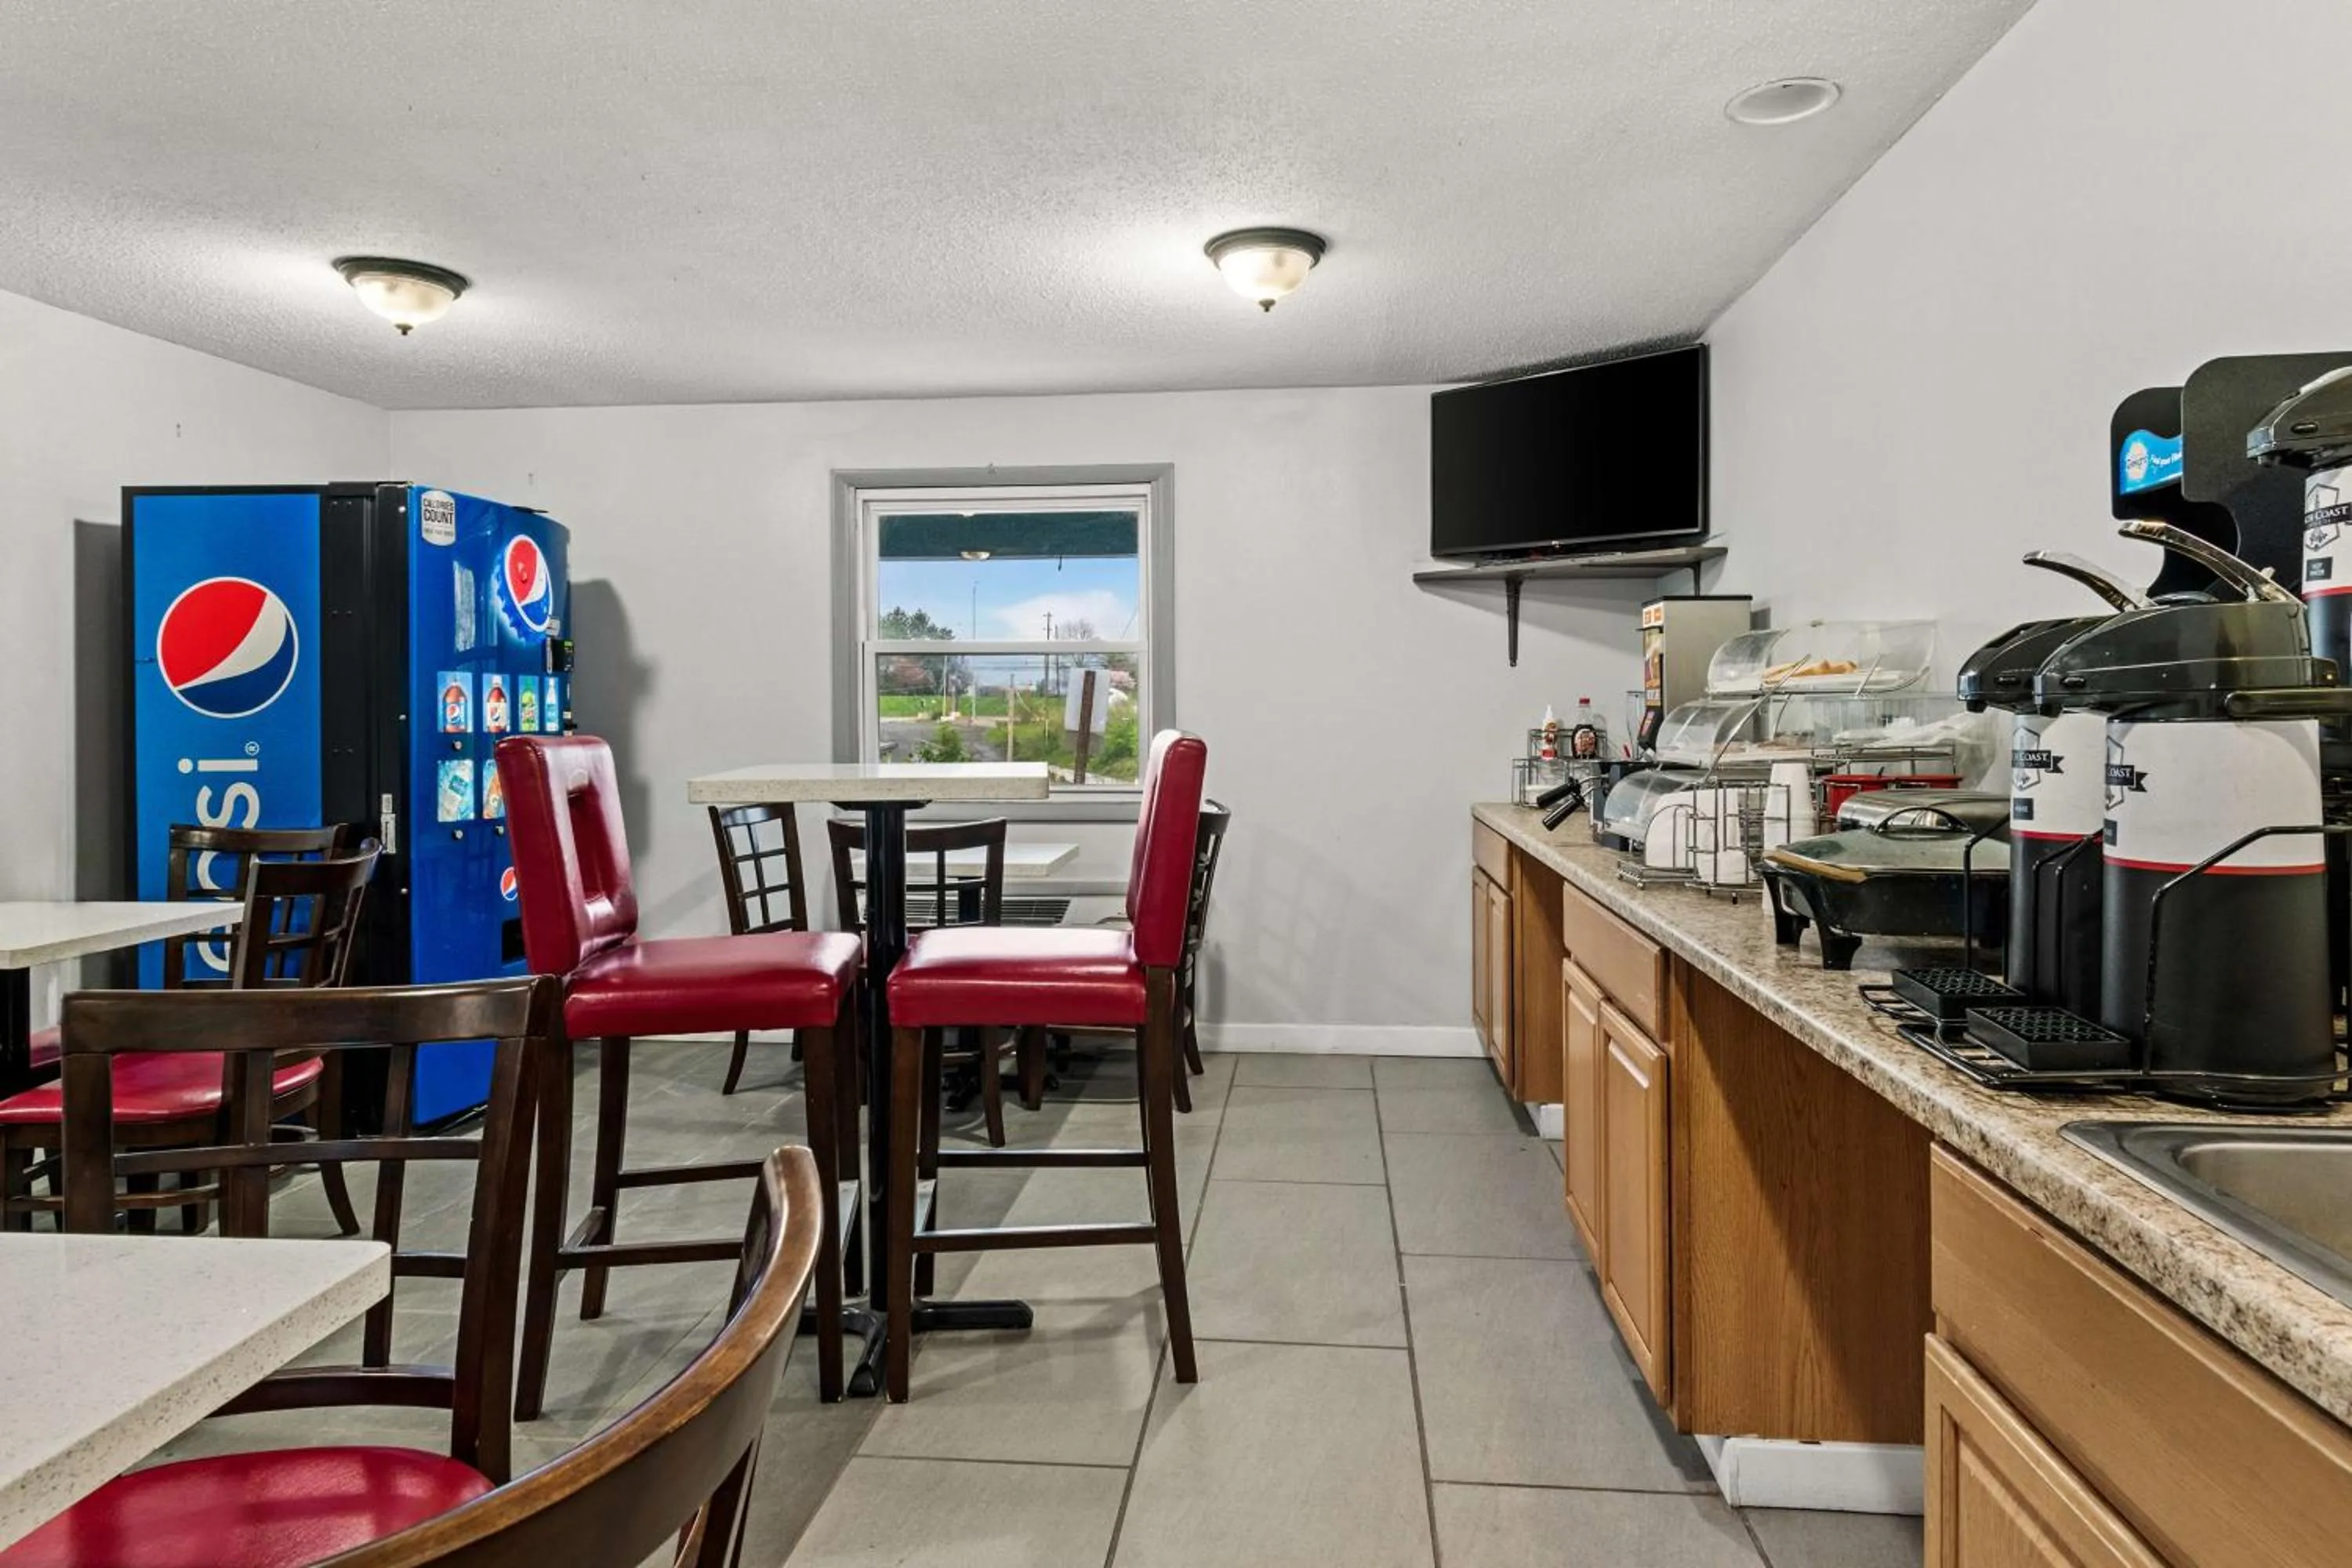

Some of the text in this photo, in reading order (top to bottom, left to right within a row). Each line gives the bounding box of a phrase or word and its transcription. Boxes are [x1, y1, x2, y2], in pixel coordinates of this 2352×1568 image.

[423, 508, 454, 524] COUNT
[2315, 506, 2349, 518] COAST
[2020, 753, 2049, 761] COAST
[178, 758, 281, 973] psi
